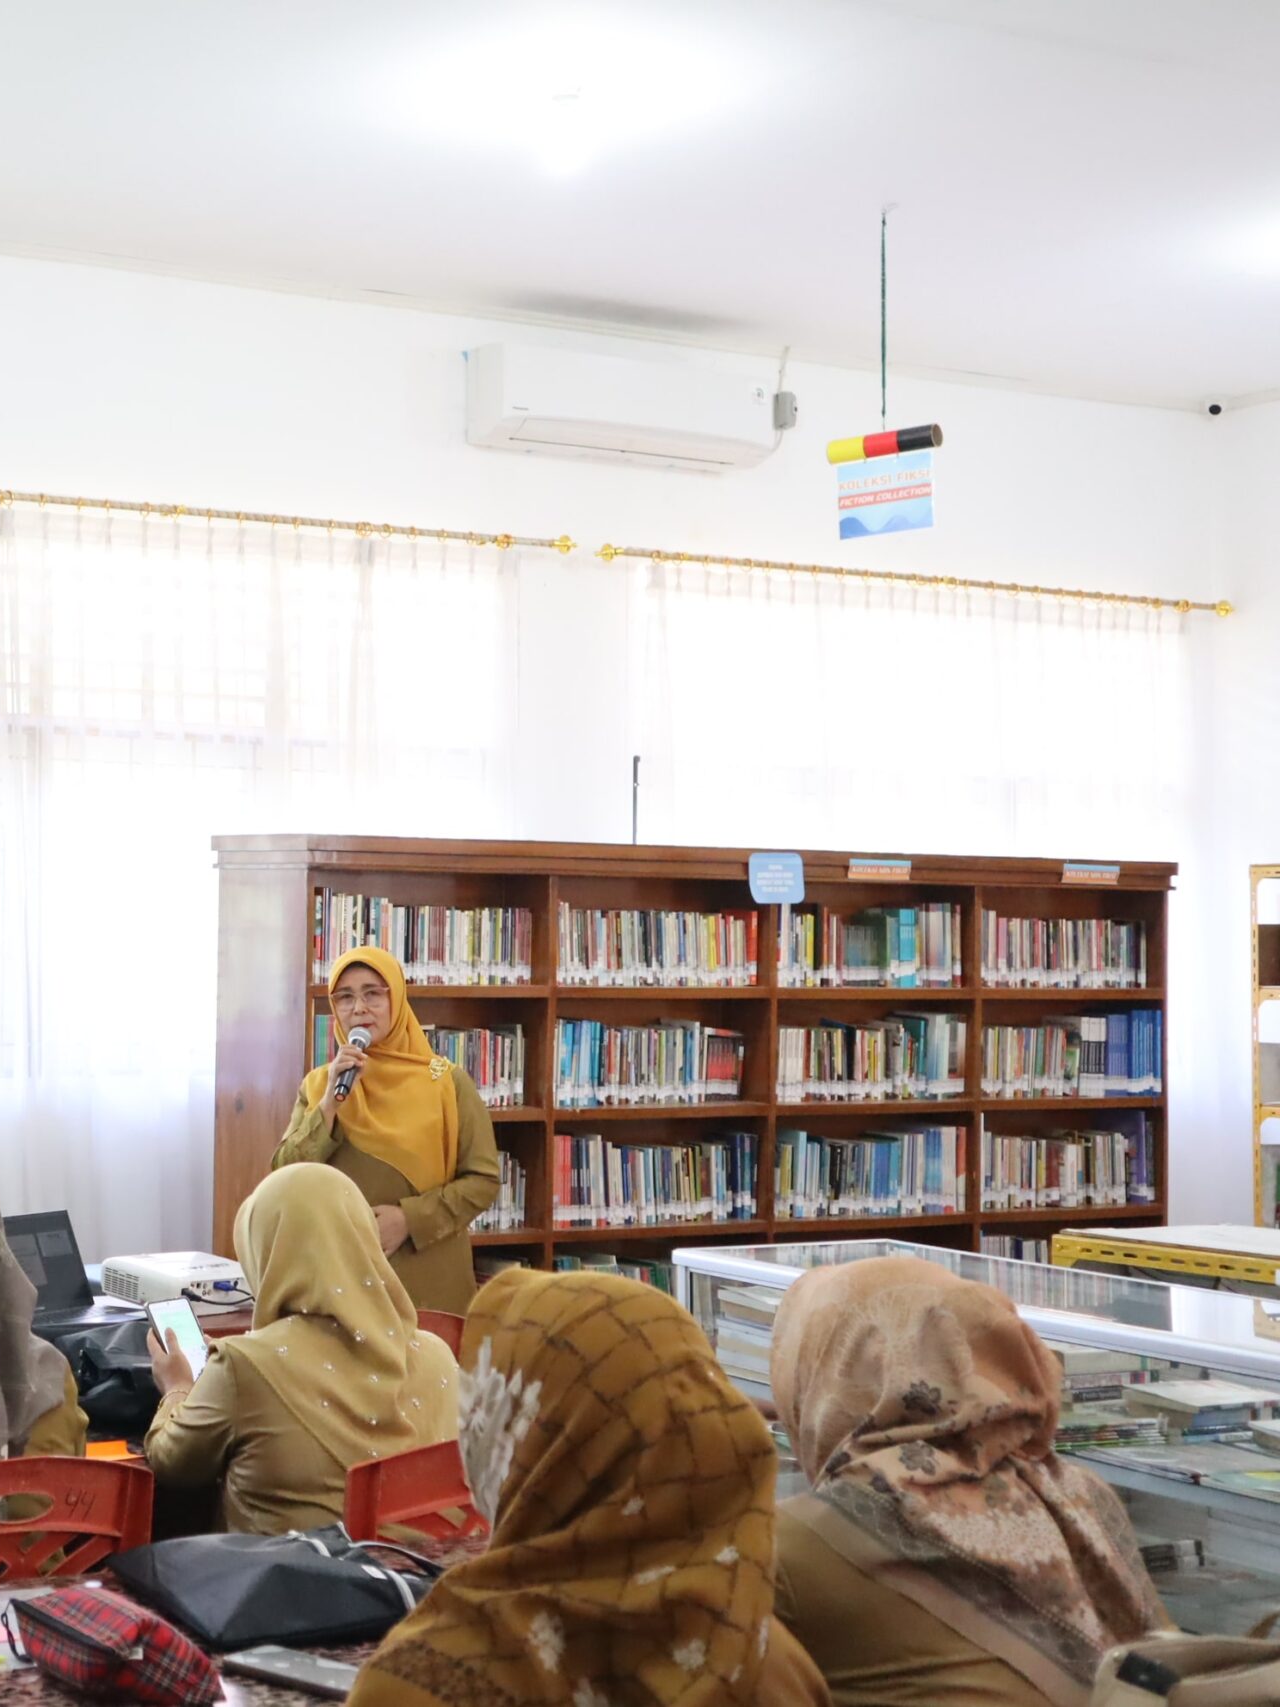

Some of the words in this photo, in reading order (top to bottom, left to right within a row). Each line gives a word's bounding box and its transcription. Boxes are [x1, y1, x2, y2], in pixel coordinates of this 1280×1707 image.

[839, 474, 892, 491] KOLEKSI
[897, 470, 930, 482] FIKSI
[840, 494, 874, 507] FICTION
[875, 487, 931, 502] COLLECTION
